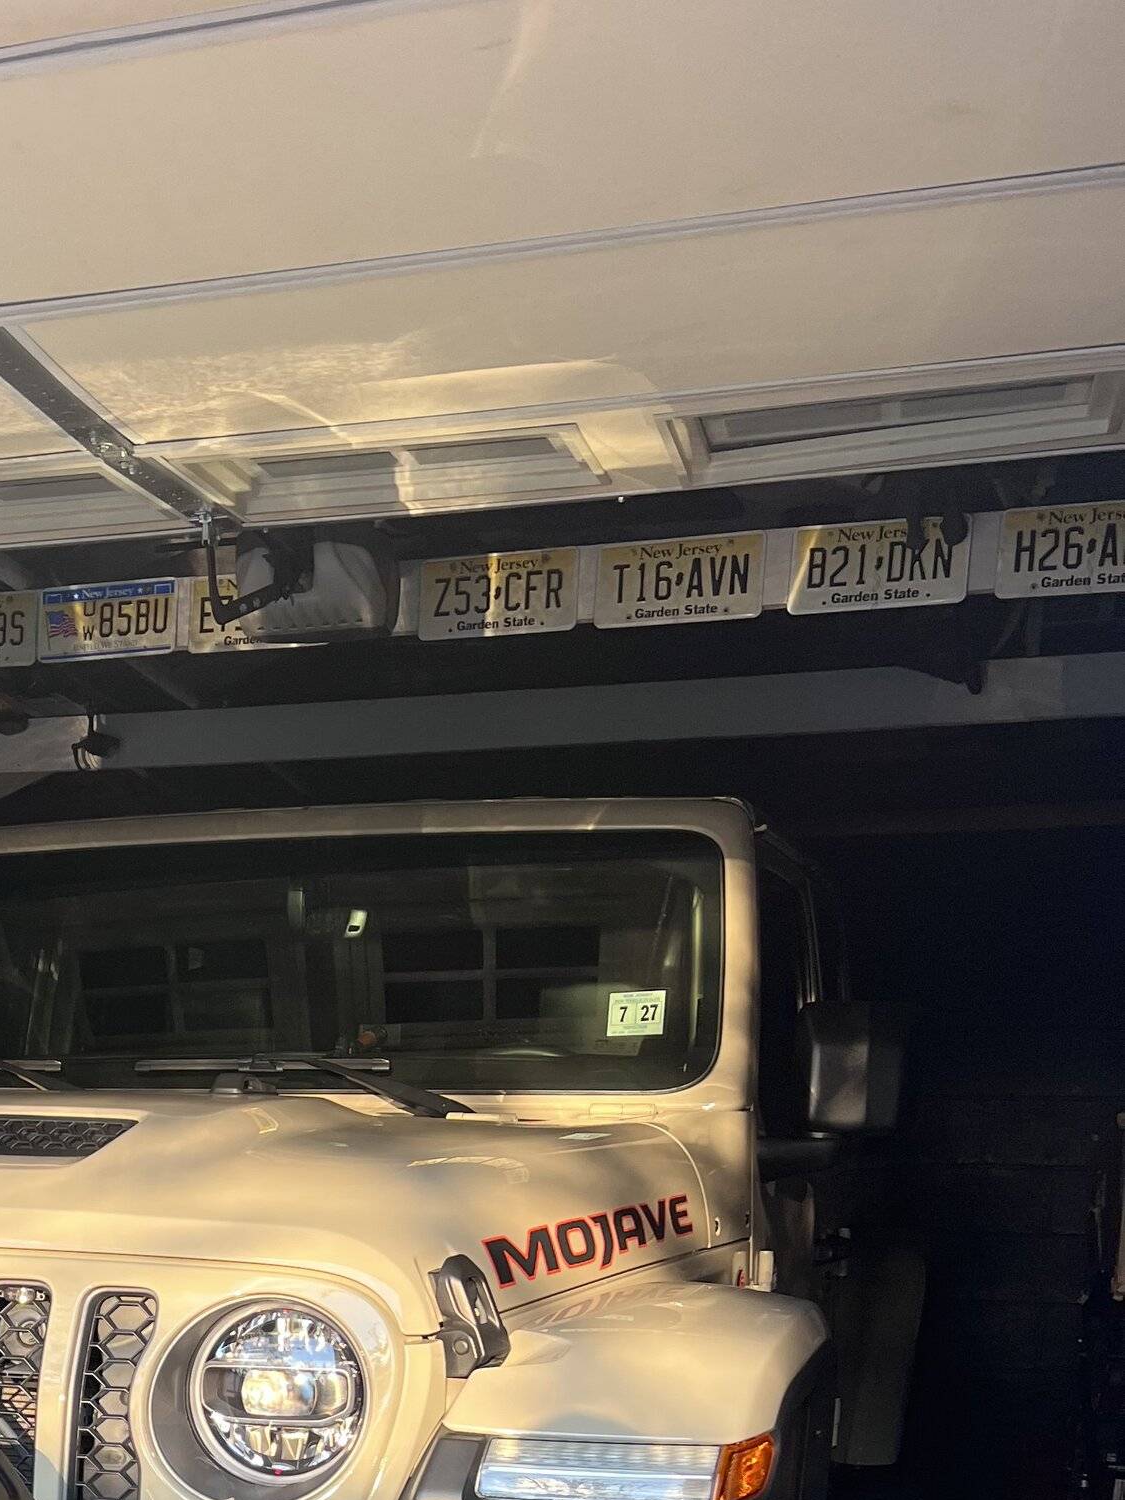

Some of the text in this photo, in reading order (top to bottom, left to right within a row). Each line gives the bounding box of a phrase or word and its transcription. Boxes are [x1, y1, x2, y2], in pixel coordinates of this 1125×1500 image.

[1089, 507, 1125, 524] Jers
[838, 525, 907, 542] New Jers
[640, 543, 722, 559] New Jersey
[459, 558, 538, 573] New Jersey
[1041, 575, 1091, 588] Garden
[831, 588, 920, 604] Garden State
[635, 603, 718, 619] Garden State
[457, 616, 536, 631] Garden State
[619, 1004, 659, 1022] 7 27
[481, 1194, 694, 1289] MOJAVE
